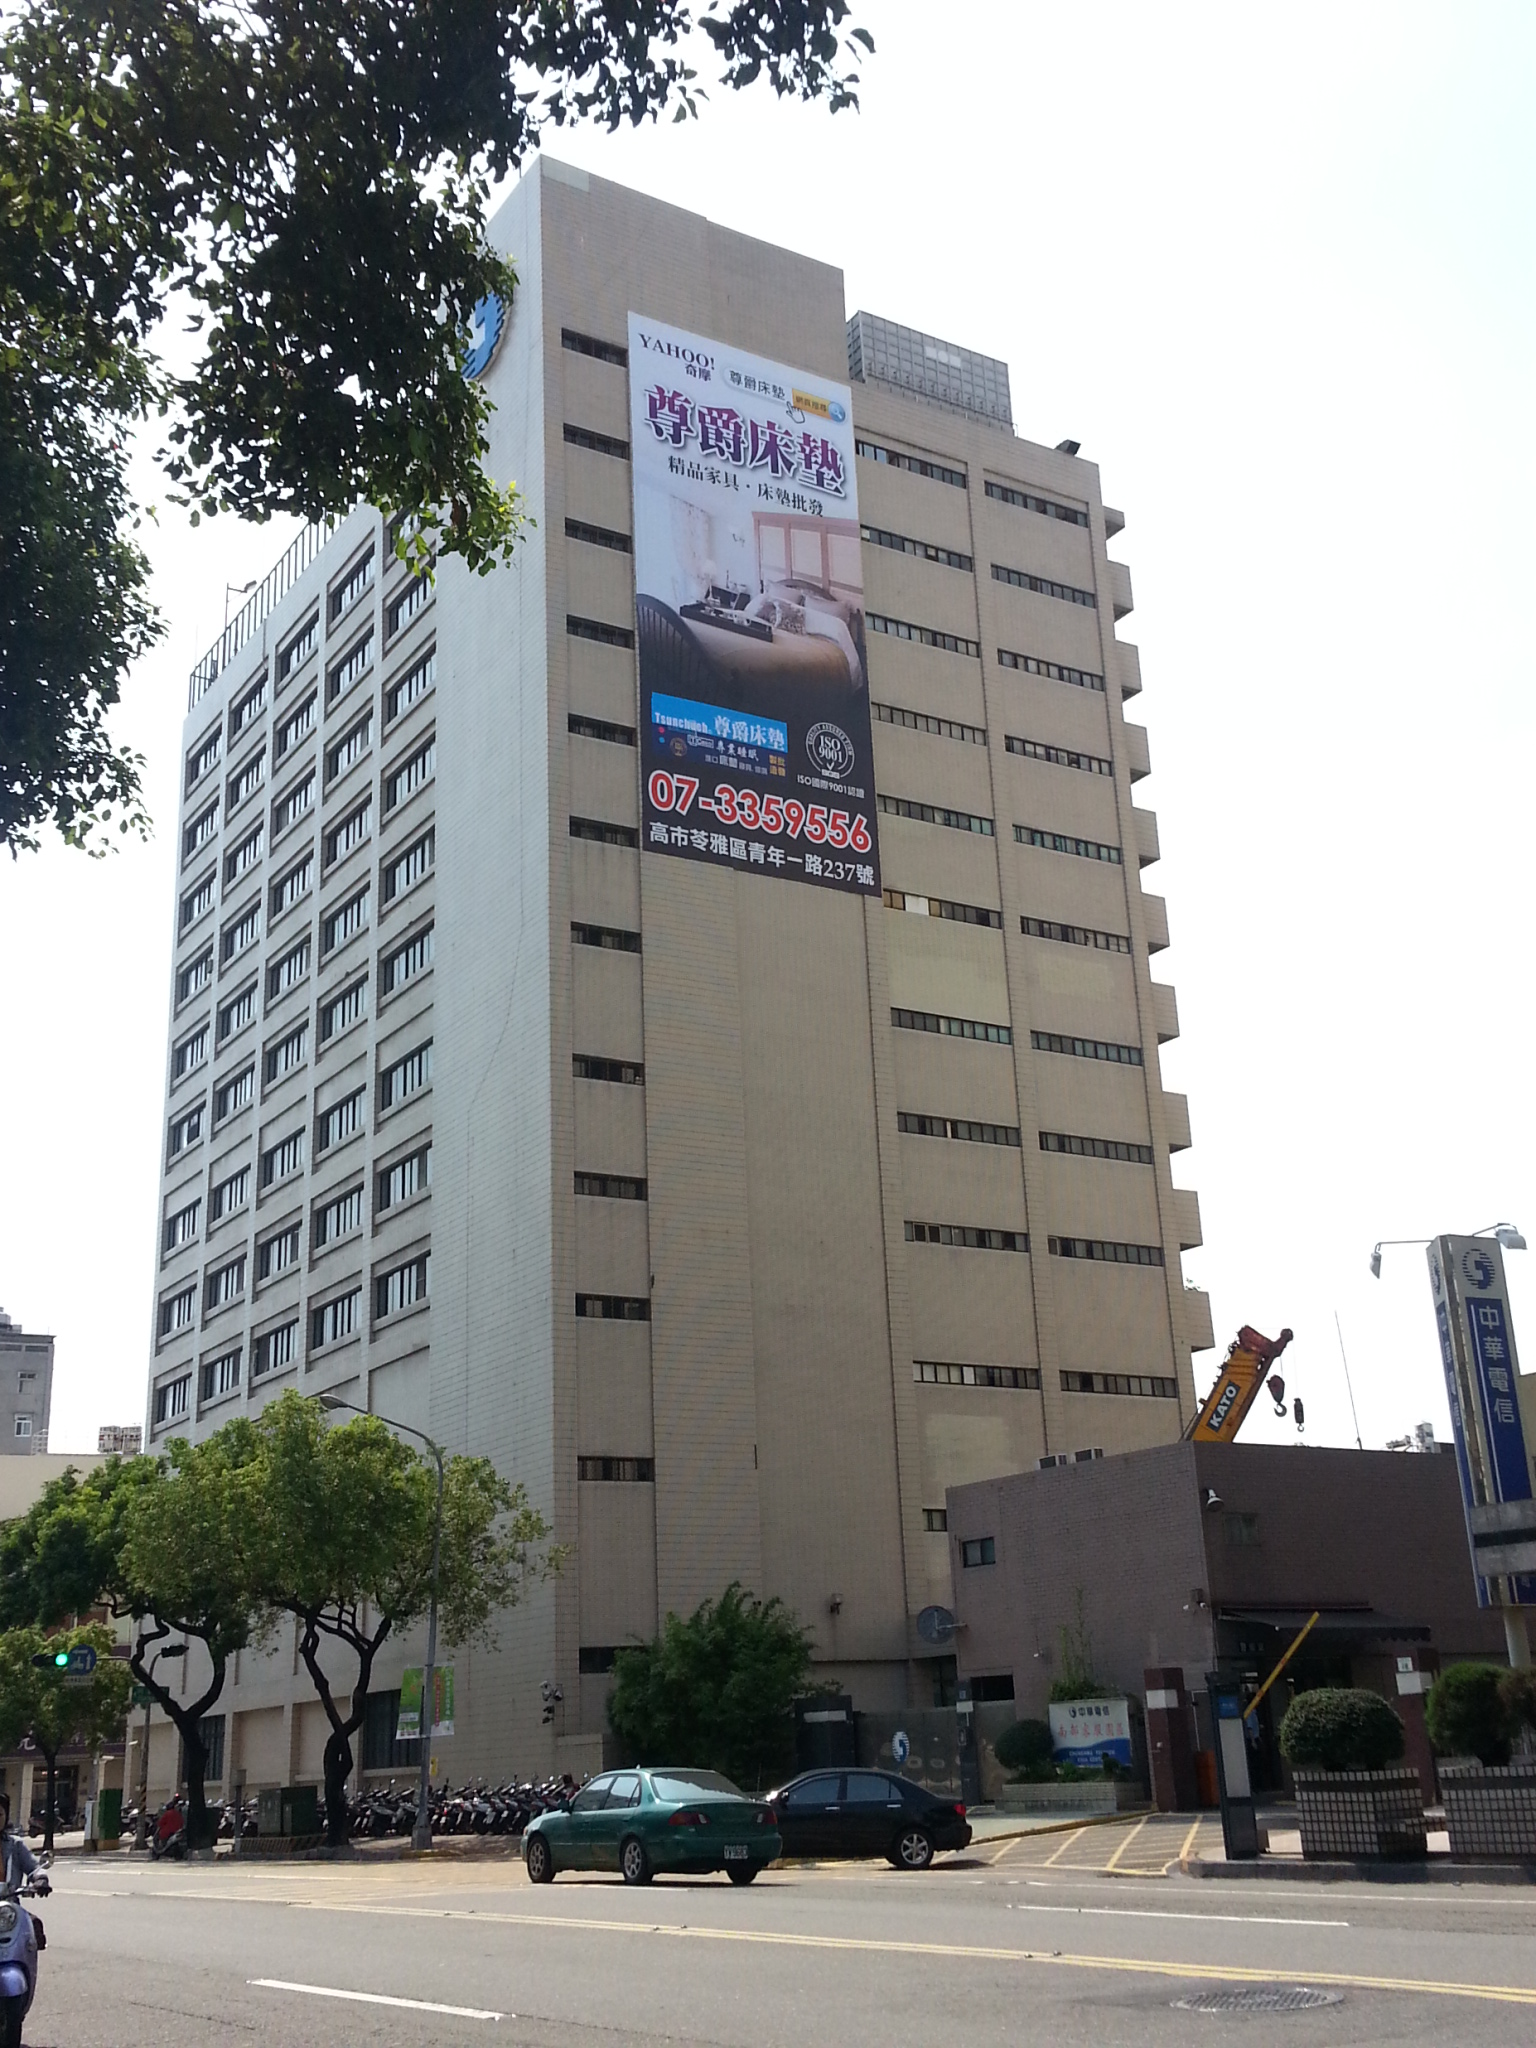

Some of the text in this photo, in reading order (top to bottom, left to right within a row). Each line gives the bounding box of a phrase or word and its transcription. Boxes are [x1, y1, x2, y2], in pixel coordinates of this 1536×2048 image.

[638, 333, 715, 370] YAHOO!
[685, 363, 712, 382] 奇摩
[729, 370, 785, 401] 尊爵床墊
[644, 384, 846, 498] 尊爵床墊
[714, 715, 785, 751] 尊爵床墊
[820, 735, 840, 751] ISO
[819, 746, 842, 763] 9001
[648, 769, 872, 853] 07-3359556
[649, 822, 875, 886] 高市苓雅區青年一路237號
[1479, 1305, 1514, 1423] 中華電信
[1209, 1385, 1237, 1427] KATO
